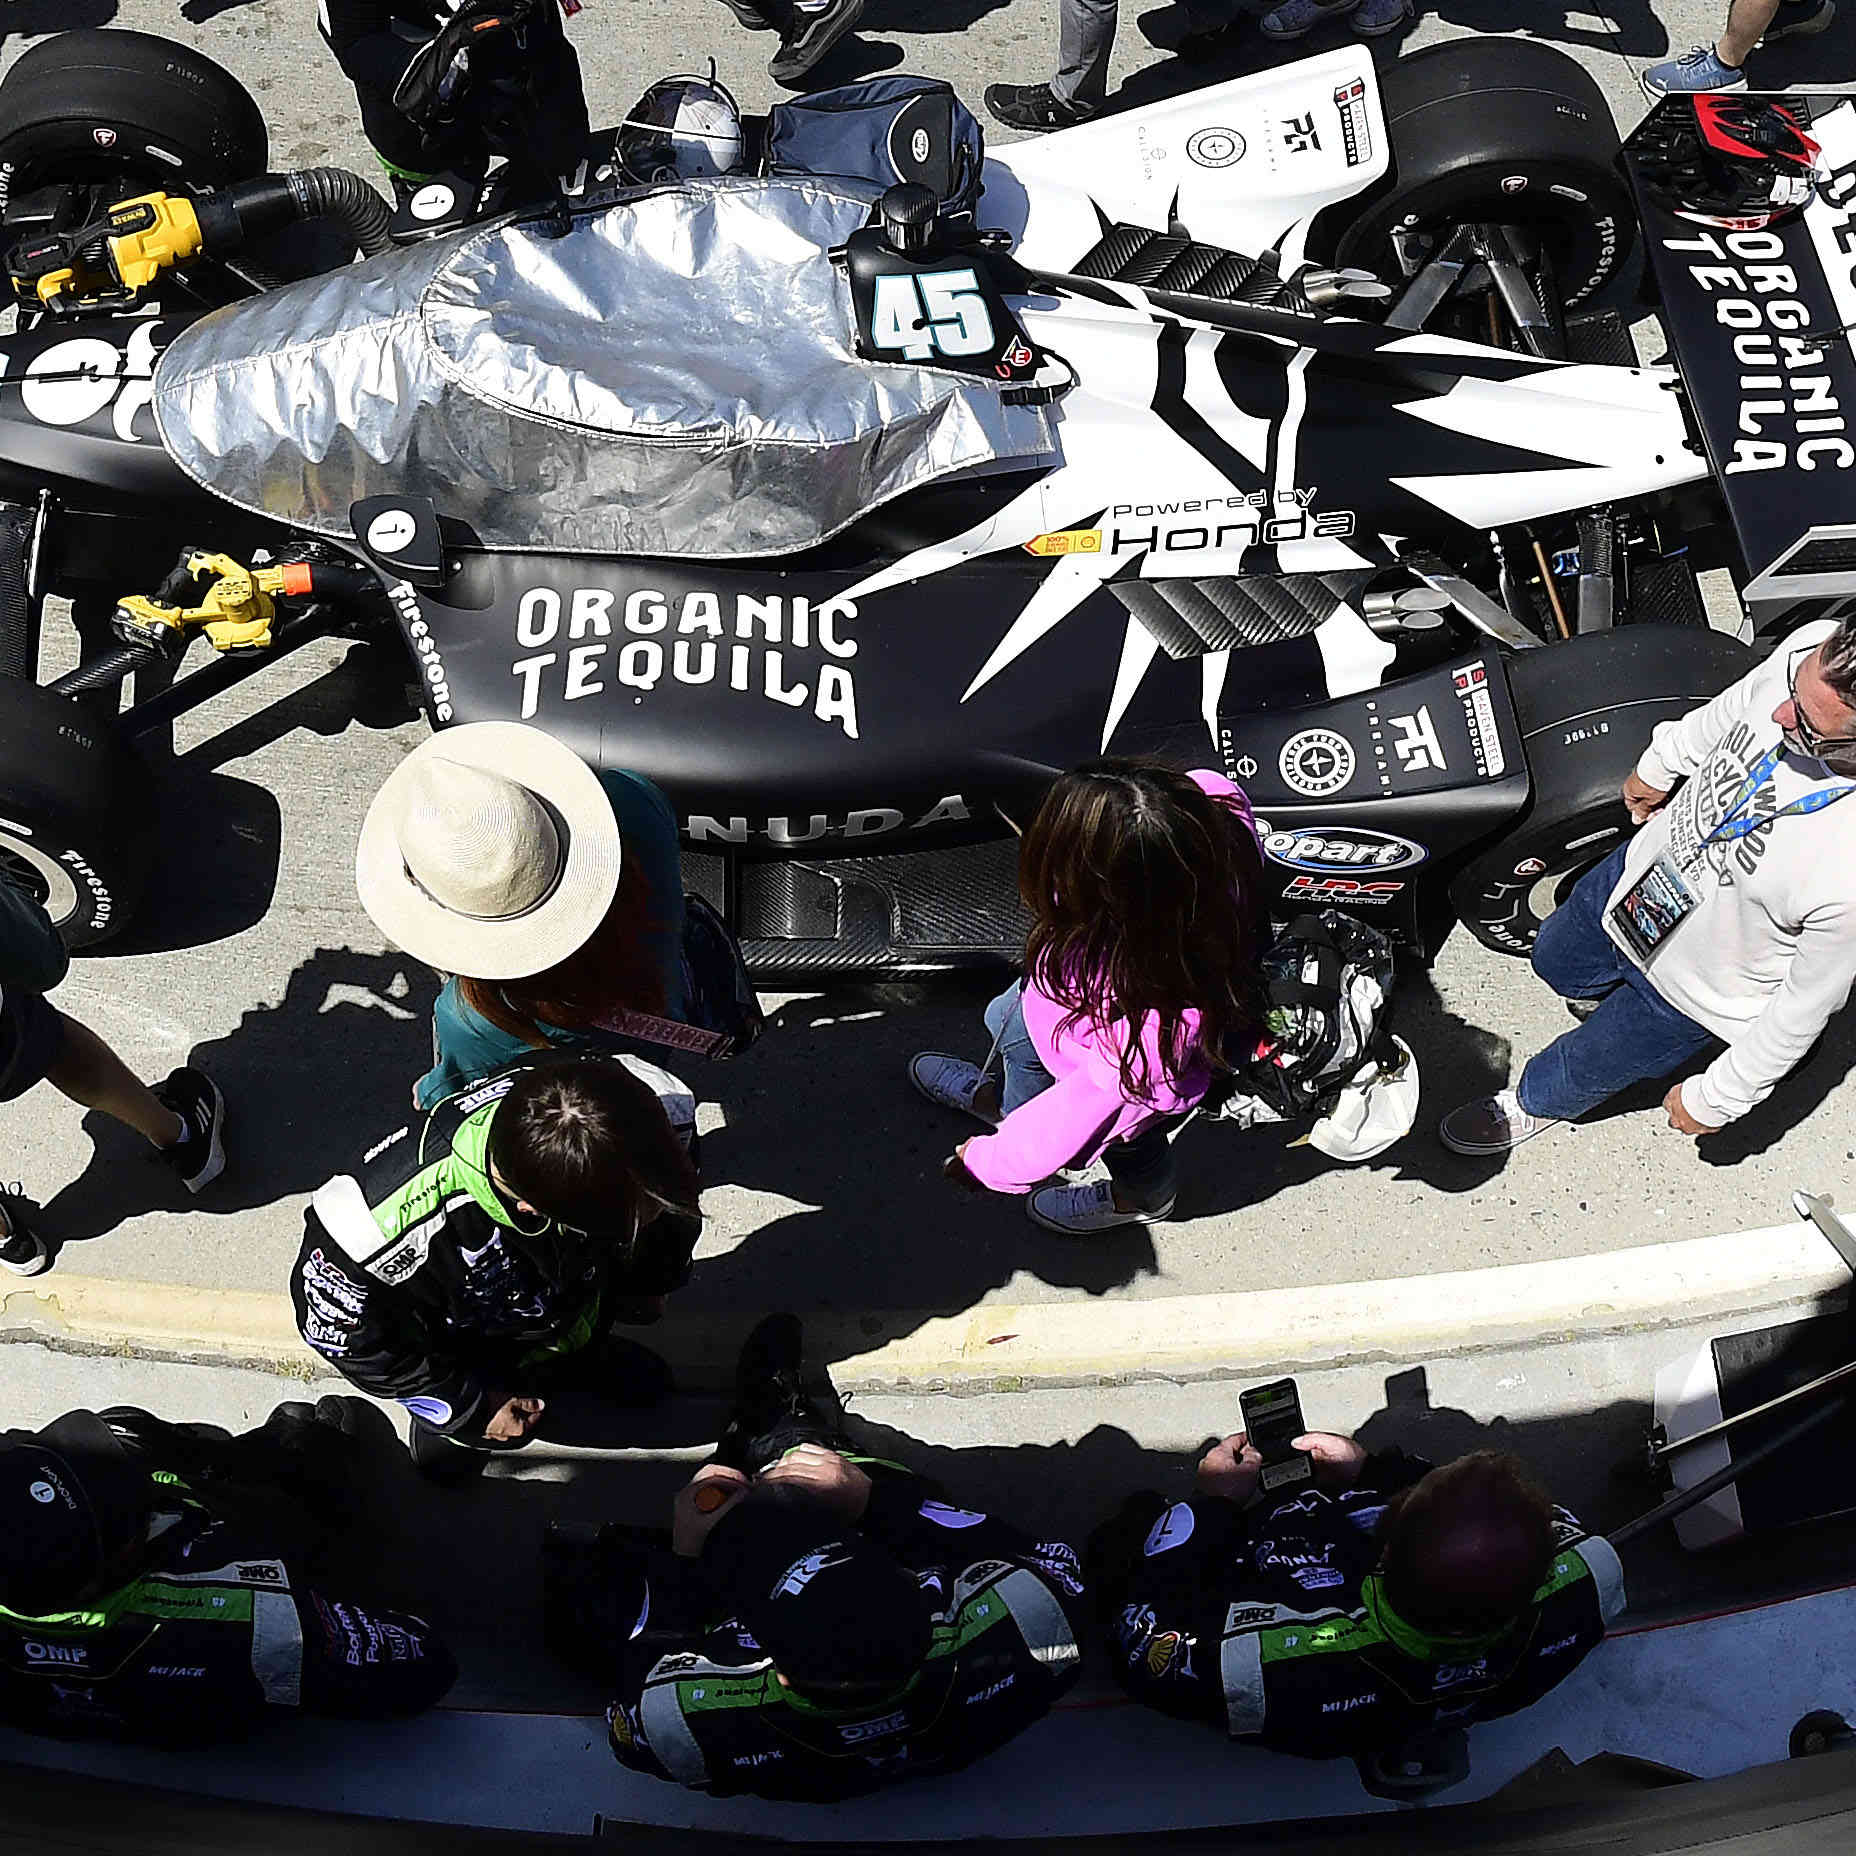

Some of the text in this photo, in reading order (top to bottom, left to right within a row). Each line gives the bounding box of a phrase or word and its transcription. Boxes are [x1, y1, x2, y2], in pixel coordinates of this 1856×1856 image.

[1570, 214, 1617, 312] Firestone
[872, 267, 997, 362] 45
[1662, 233, 1790, 478] TEQUILA
[1722, 229, 1856, 475] ORGANIC
[1113, 485, 1317, 521] Powered by
[1110, 510, 1356, 555] Honda
[515, 586, 861, 660] ORGANIC
[387, 579, 454, 724] Firestone
[512, 638, 861, 740] TEQUILA
[1473, 692, 1495, 732] HAVEN
[1464, 699, 1487, 776] PRODUCTS
[1482, 732, 1506, 777] STEEL
[685, 794, 974, 846] NUDA
[1259, 816, 1405, 870] opart
[1283, 876, 1405, 902] HRC
[1325, 894, 1388, 905] RACING
[383, 1247, 417, 1274] OMP
[24, 1641, 87, 1664] OMP
